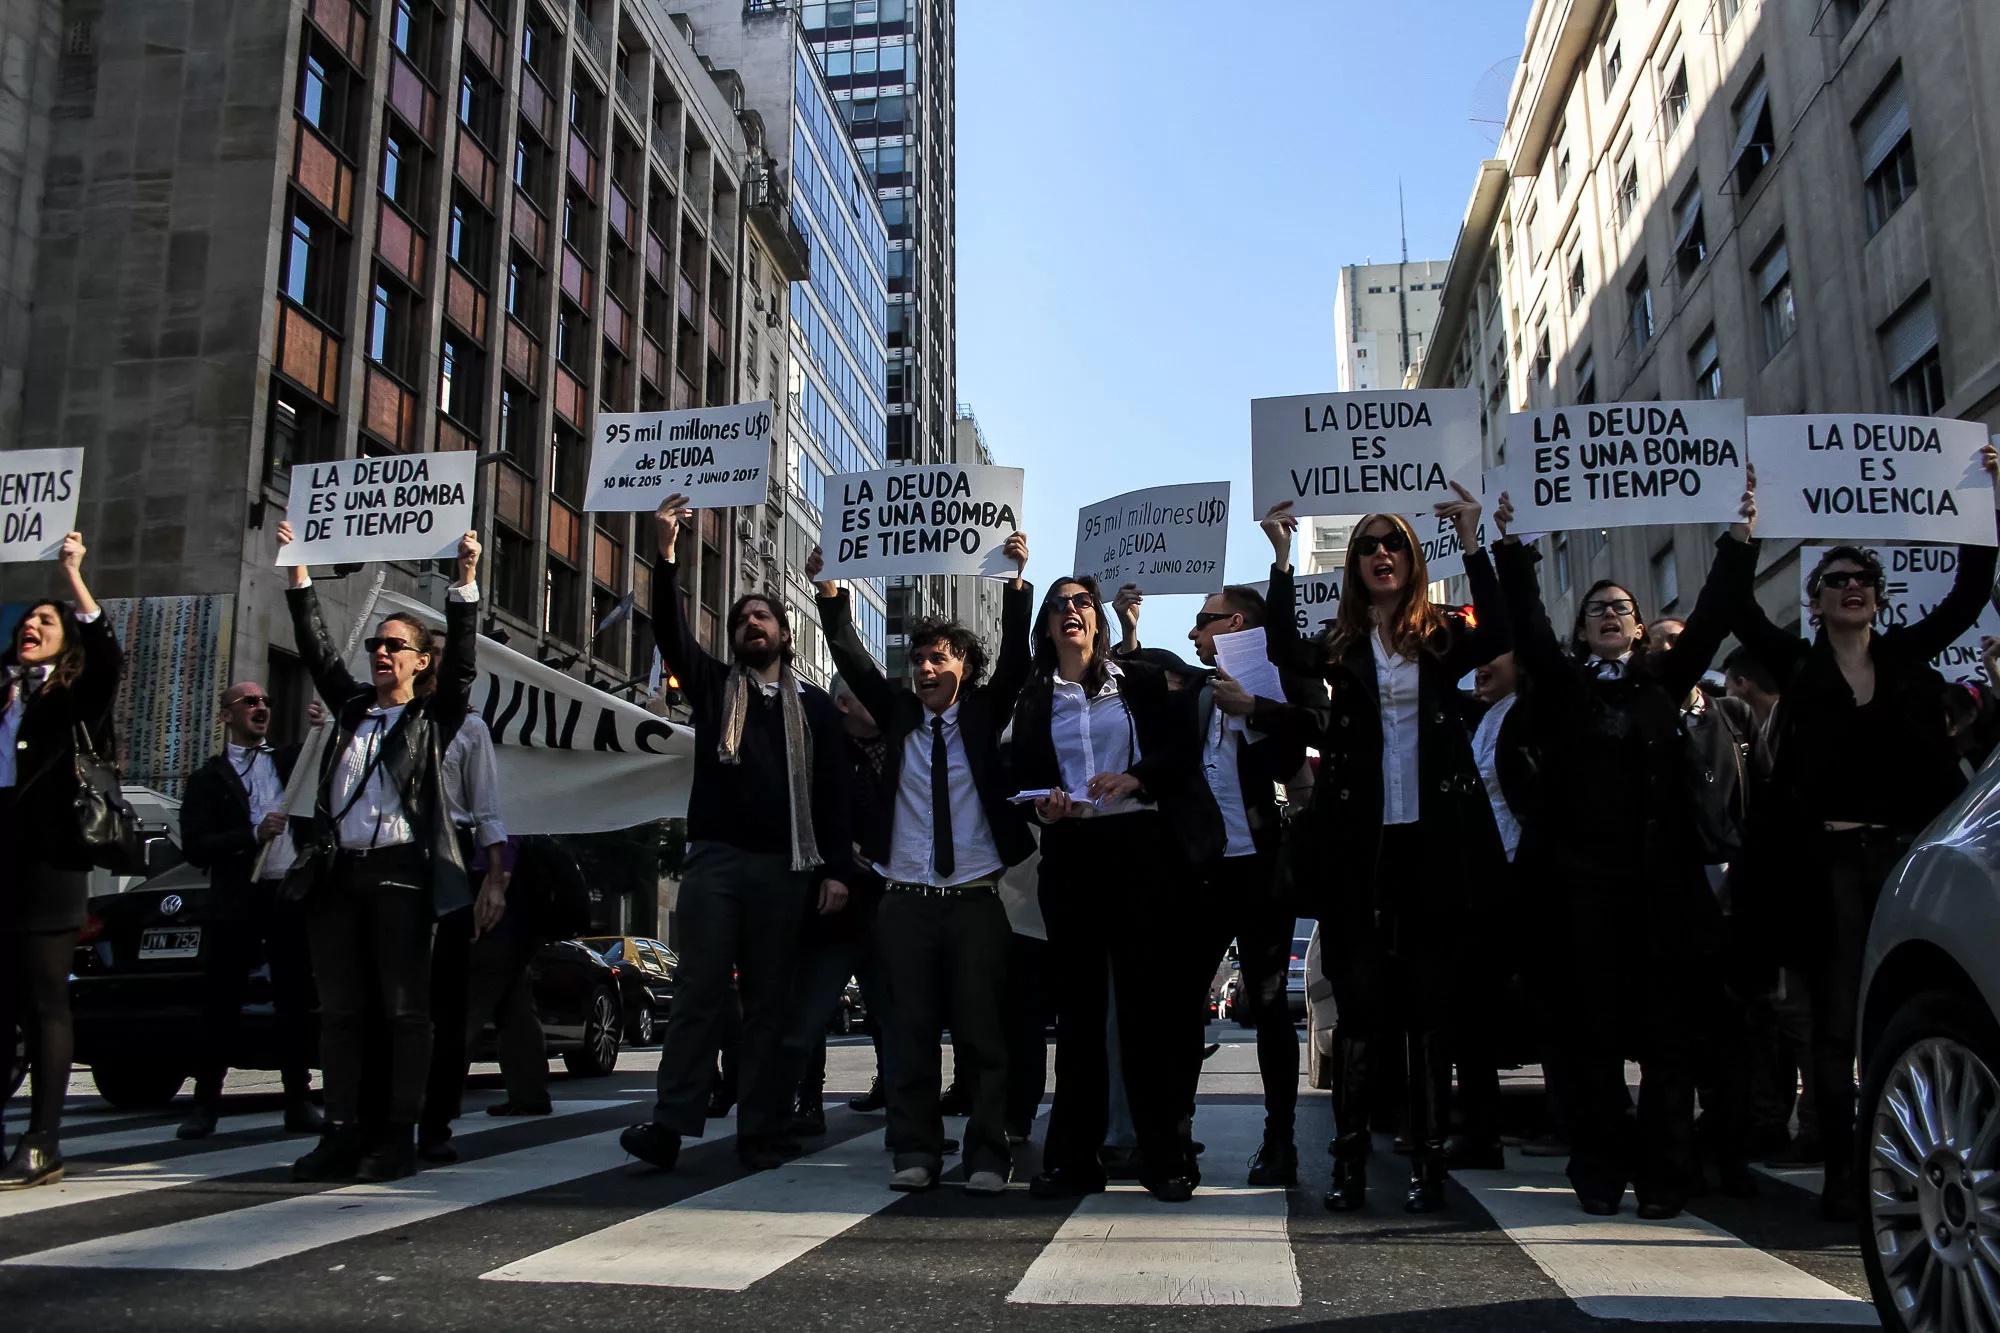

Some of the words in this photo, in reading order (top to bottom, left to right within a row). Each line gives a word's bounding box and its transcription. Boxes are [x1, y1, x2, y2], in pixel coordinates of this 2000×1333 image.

[606, 424, 630, 443] 95
[635, 420, 662, 441] mil
[670, 418, 740, 441] millones
[746, 411, 769, 440] U$D
[1305, 405, 1338, 432] LA
[1347, 402, 1432, 430] DEUDA
[1534, 413, 1570, 443] LA
[1589, 407, 1688, 438] DEUDA
[1352, 436, 1386, 460] ES
[1808, 424, 1843, 450] LA
[1854, 423, 1941, 453] DEUDA
[636, 454, 655, 470] de
[660, 446, 714, 470] DEUDA
[1535, 446, 1570, 473] ES
[1580, 440, 1638, 469] UNA
[1643, 438, 1738, 467] BOMBA
[1860, 458, 1896, 481] ES
[0, 470, 73, 505] ENTAS
[312, 465, 339, 488] LA
[353, 459, 428, 485] DEUDA
[604, 477, 615, 488] 10
[638, 475, 661, 487] 2015
[684, 474, 692, 486] 2
[698, 471, 730, 484] JUNIO
[732, 468, 759, 481] 2017
[844, 480, 873, 506] LA
[887, 471, 970, 502] DEUDA
[1291, 463, 1447, 497] VIOLENCIA
[1535, 476, 1571, 506] DE
[1583, 469, 1700, 499] TIEMPO
[309, 492, 337, 514] ES
[345, 489, 386, 510] UNA
[394, 483, 464, 507] BOMBA
[1803, 486, 1958, 515] VIOLENCIA
[4, 507, 41, 543] DÍA
[304, 518, 334, 542] DE
[344, 510, 433, 536] TIEMPO
[842, 508, 870, 532] ES
[879, 502, 926, 527] UNA
[931, 500, 1016, 535] BOMBA
[1085, 516, 1101, 541] 95
[1105, 507, 1122, 533] mil
[1128, 502, 1194, 526] millones
[1198, 497, 1225, 527] U$D
[839, 535, 869, 563] DE
[877, 528, 980, 556] TIEMPO
[1104, 546, 1115, 563] de
[1119, 532, 1166, 557] DEUDA
[1893, 549, 1956, 572] DEUD
[1105, 565, 1119, 579] 2015
[1138, 561, 1144, 574] 2
[1150, 560, 1181, 574] JUNIO
[1186, 560, 1215, 573] 2017
[1294, 582, 1340, 606] EUDA
